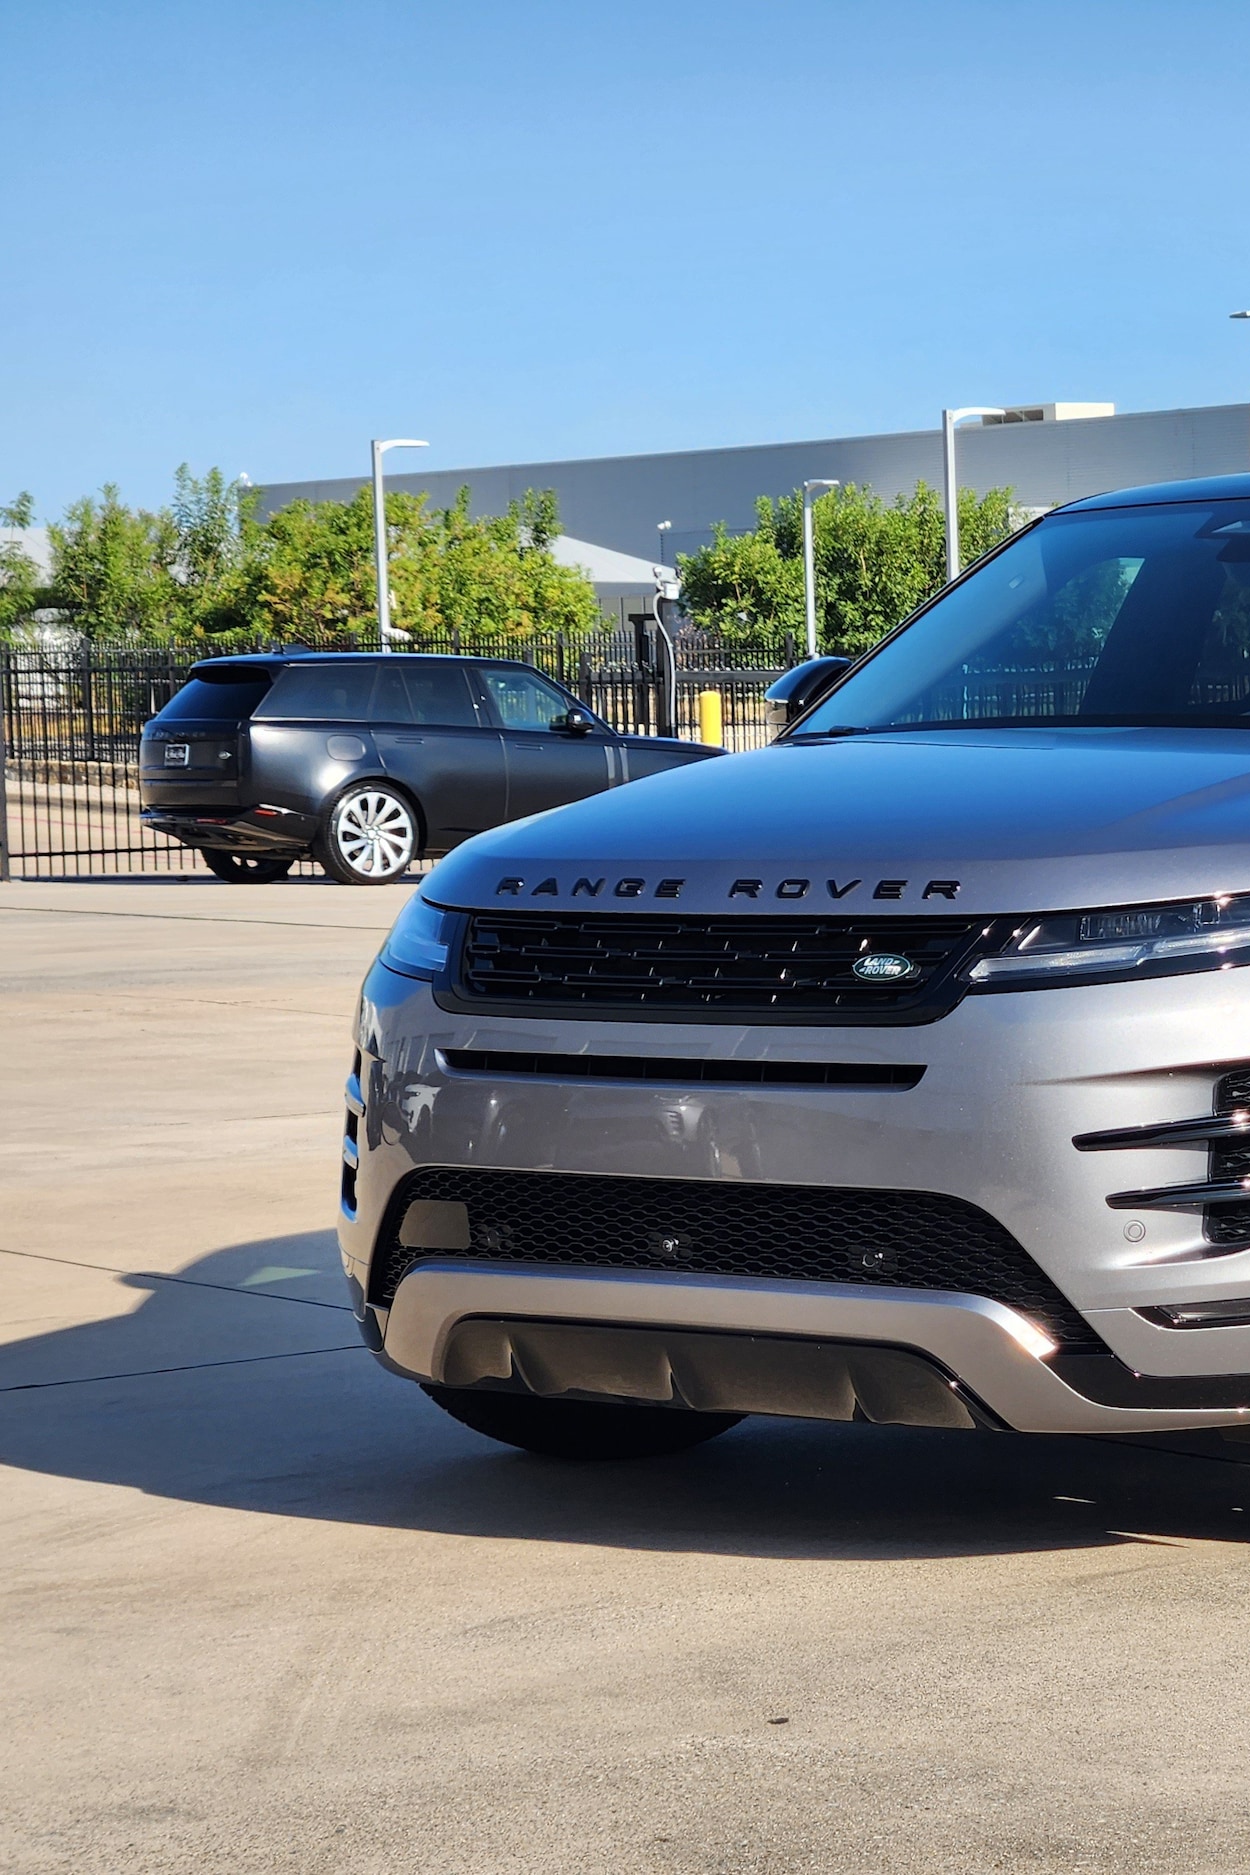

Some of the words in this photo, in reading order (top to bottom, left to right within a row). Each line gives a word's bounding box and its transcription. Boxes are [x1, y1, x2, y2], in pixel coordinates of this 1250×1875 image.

[496, 876, 687, 898] RANGE
[727, 878, 961, 900] ROVER
[863, 957, 894, 966] LAND
[863, 965, 902, 975] ROVER
